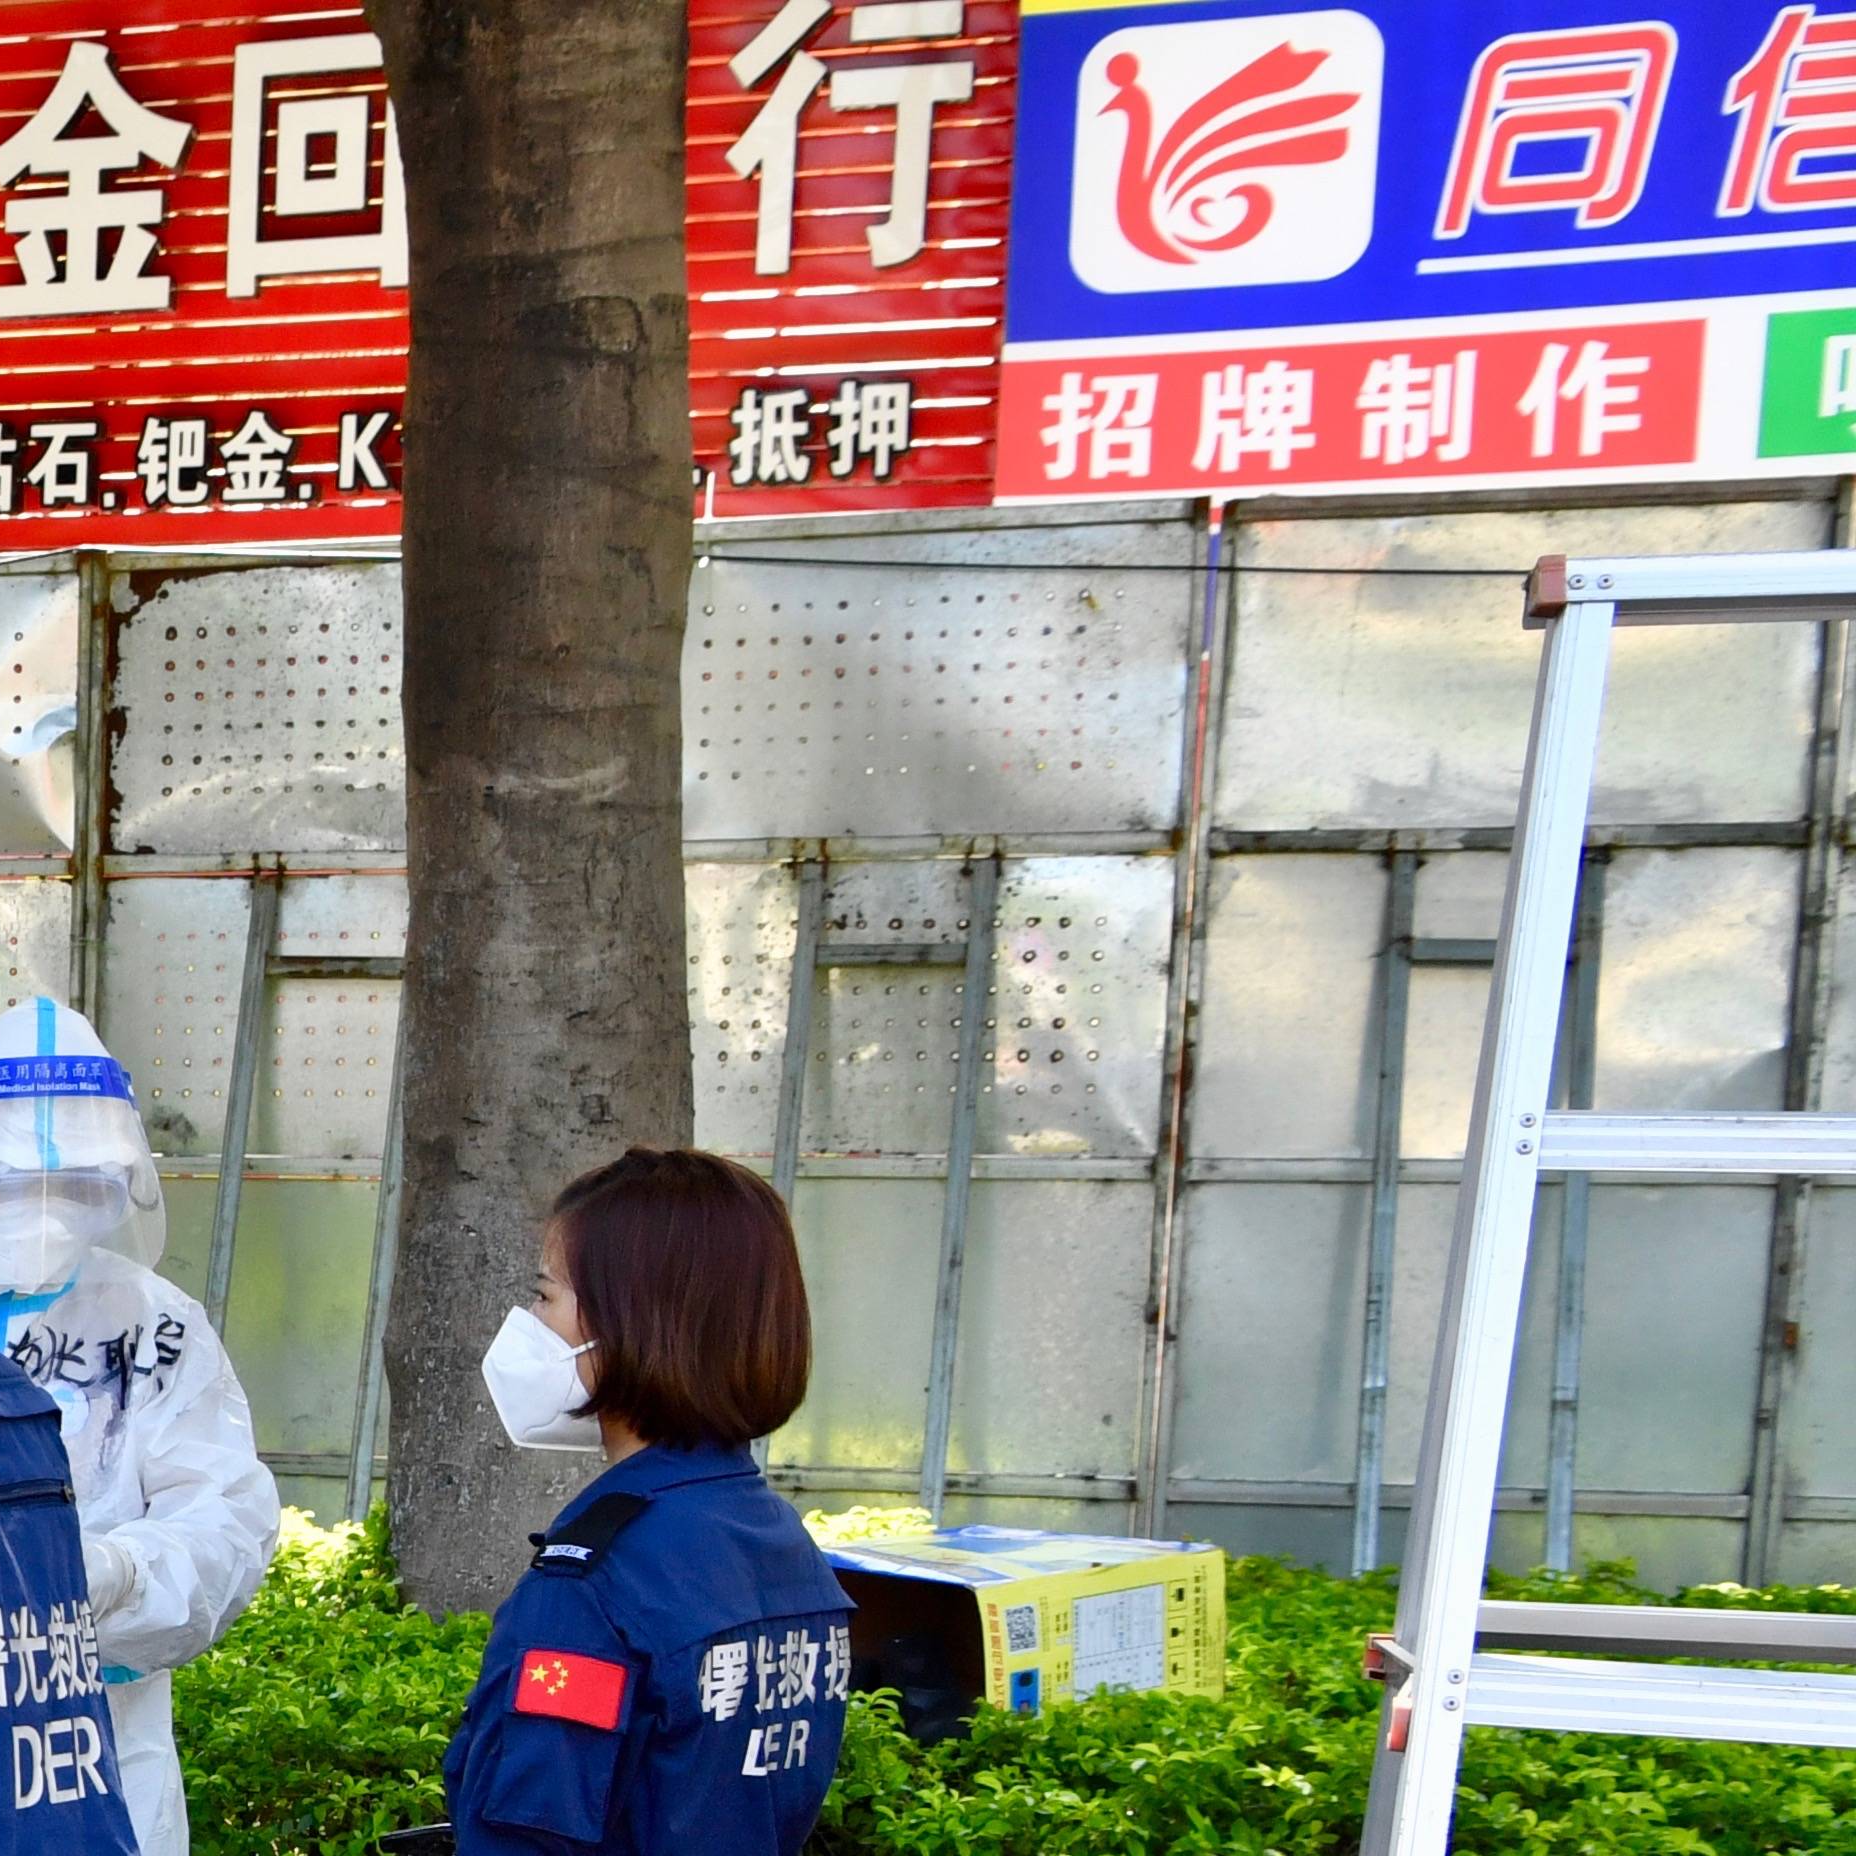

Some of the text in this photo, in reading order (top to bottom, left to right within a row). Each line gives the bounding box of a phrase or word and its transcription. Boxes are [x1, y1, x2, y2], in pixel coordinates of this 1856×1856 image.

[1041, 340, 1652, 480] 招牌制作
[36, 1082, 78, 1092] Isolation
[12, 1716, 108, 1810] DER
